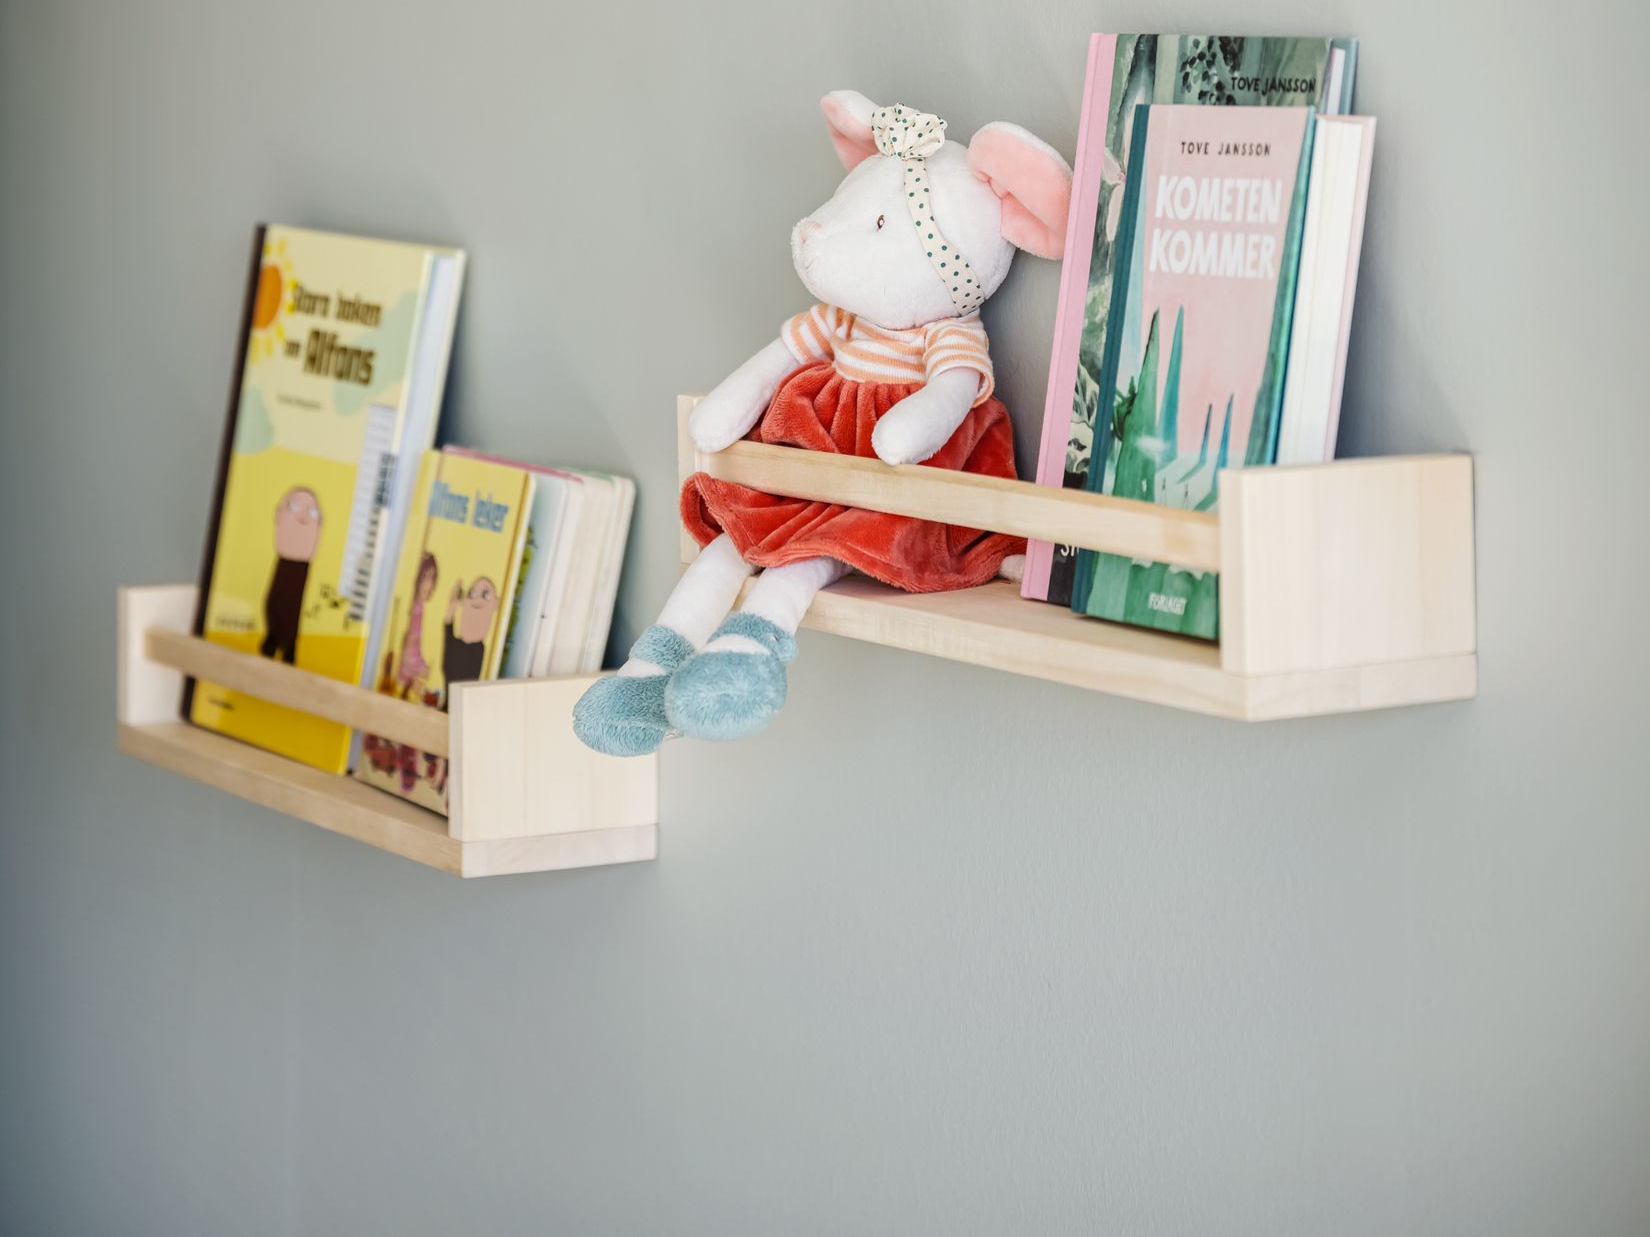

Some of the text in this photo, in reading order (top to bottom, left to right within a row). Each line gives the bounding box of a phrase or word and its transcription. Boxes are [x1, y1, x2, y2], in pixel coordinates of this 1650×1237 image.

[1231, 76, 1317, 96] TOVE JANSSON
[1180, 141, 1271, 157] TOVE JANSSON
[1155, 174, 1284, 224] KOMETEN
[1149, 228, 1277, 280] KOMMER
[304, 329, 375, 385] Alfons
